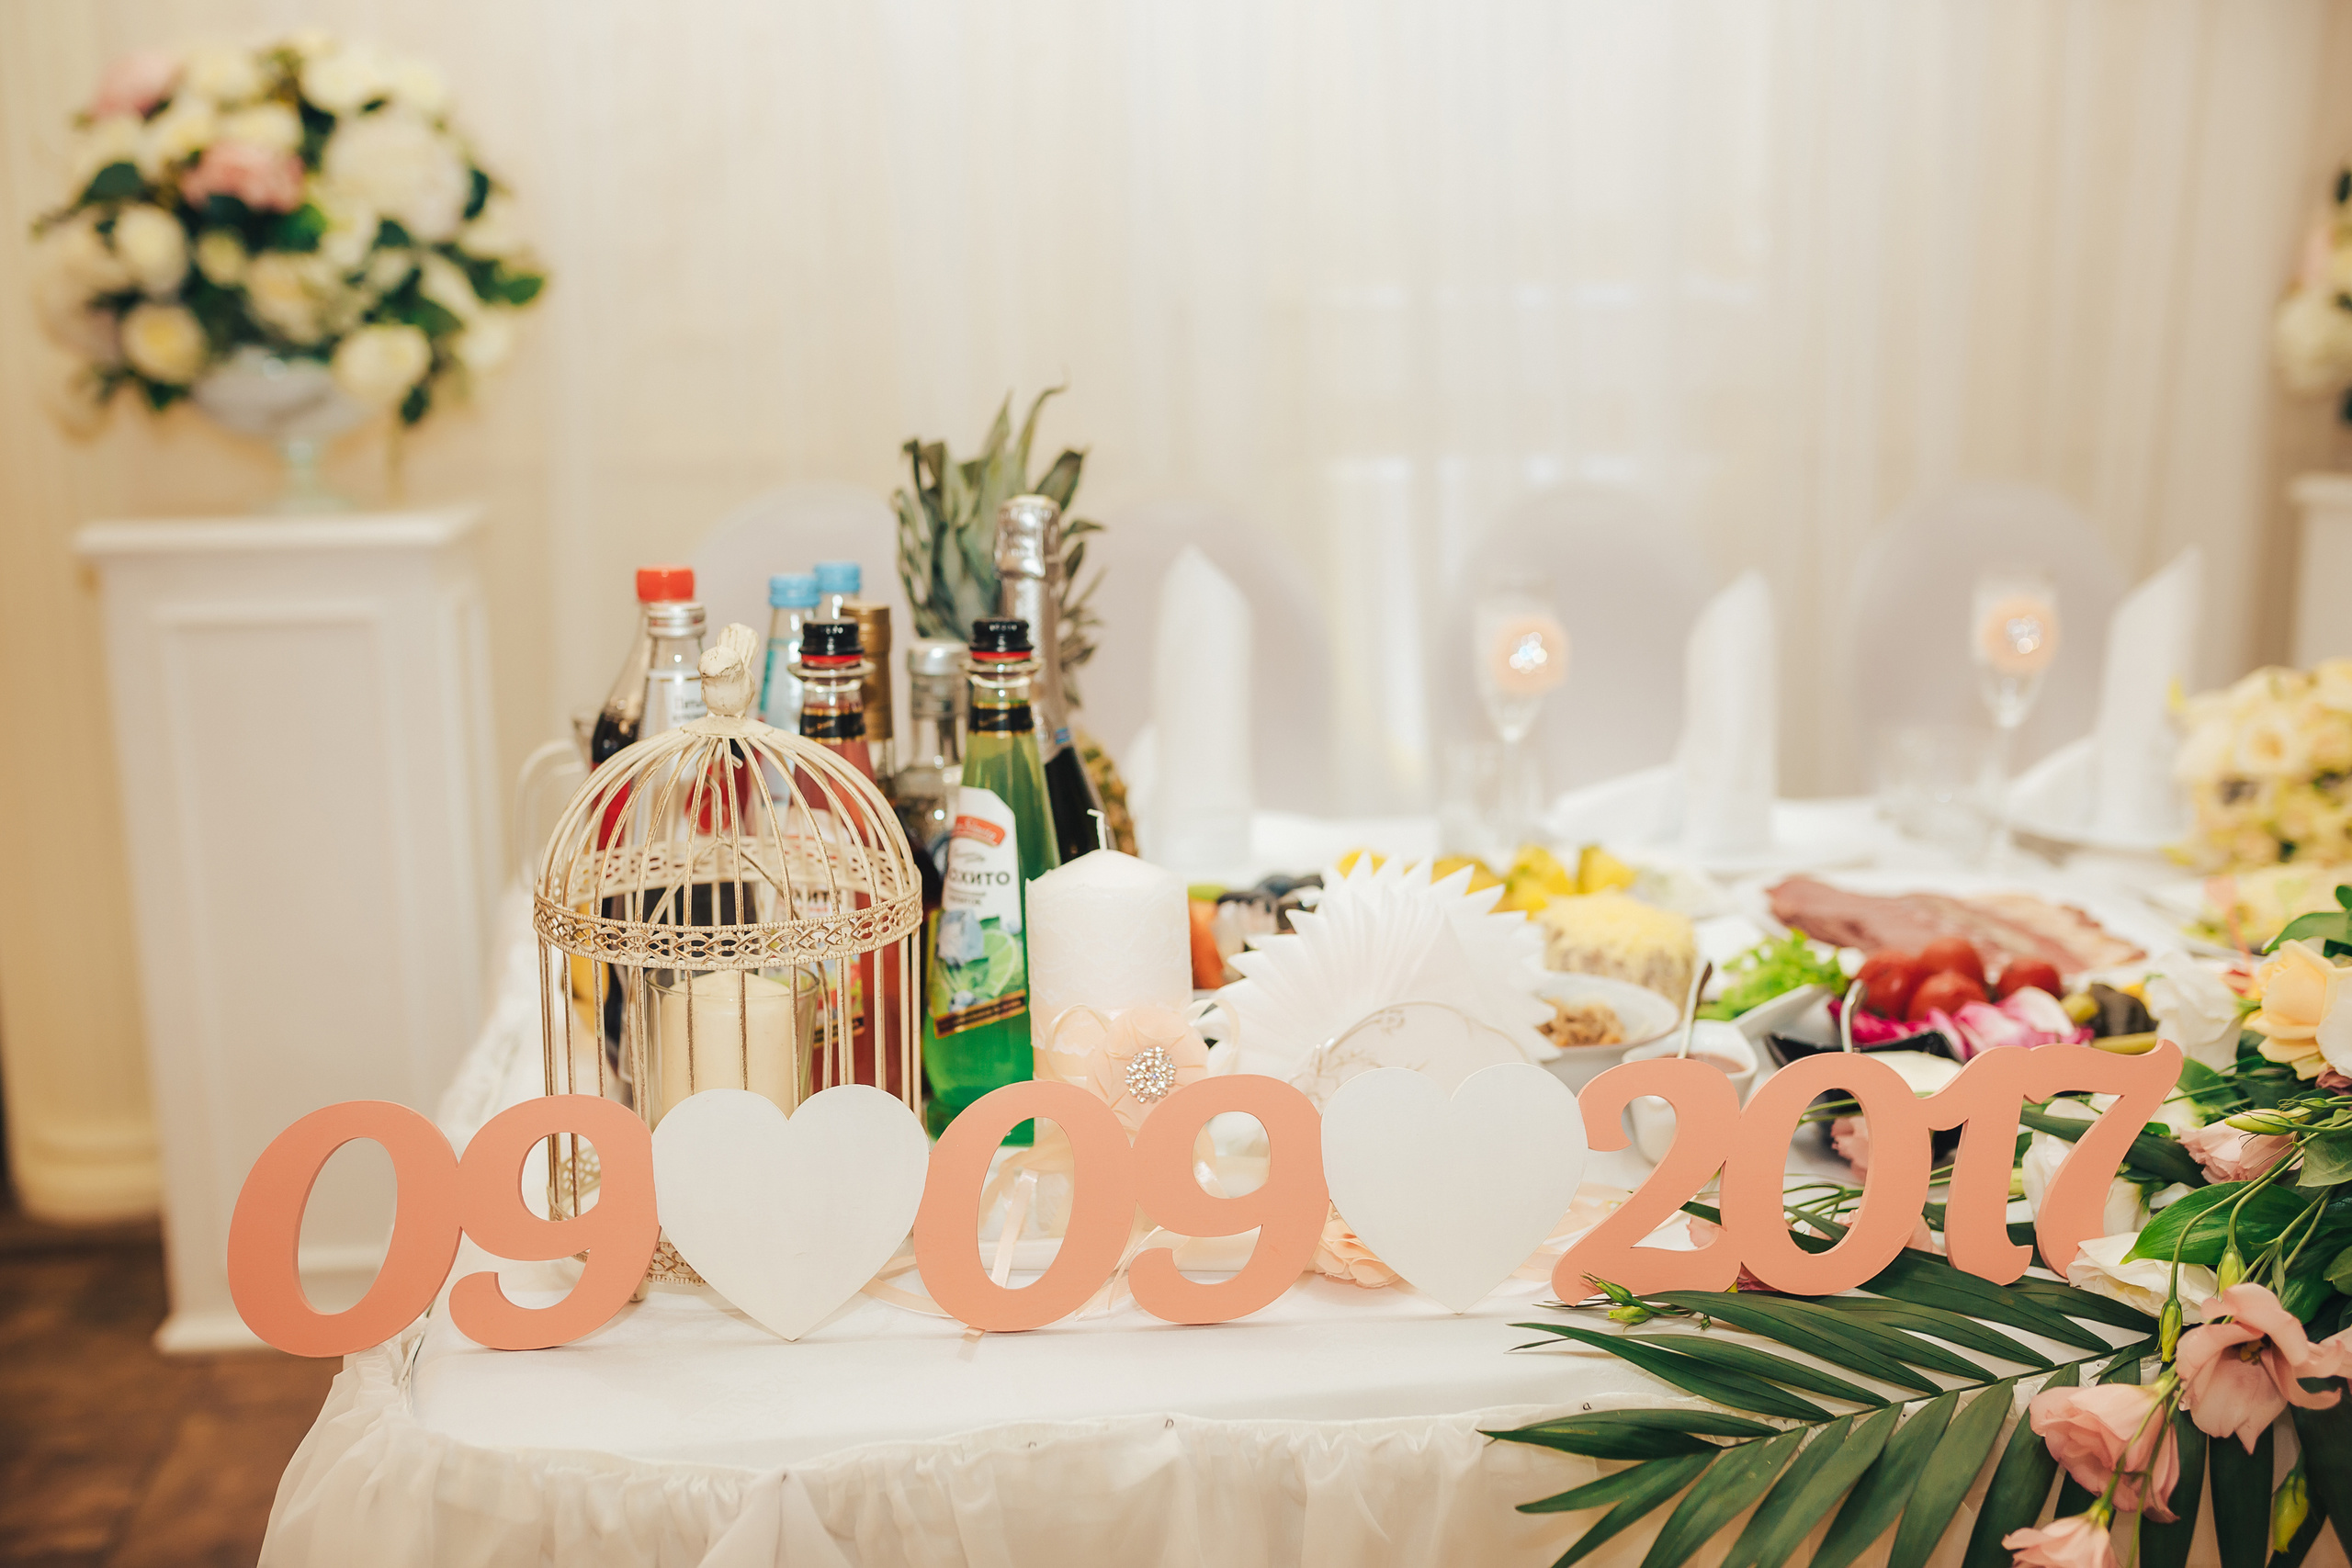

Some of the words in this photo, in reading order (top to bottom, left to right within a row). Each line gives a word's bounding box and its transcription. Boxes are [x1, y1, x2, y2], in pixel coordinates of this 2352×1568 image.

[227, 1094, 661, 1359] 09
[913, 1074, 1330, 1332] 09
[1552, 1039, 2184, 1306] 2017
